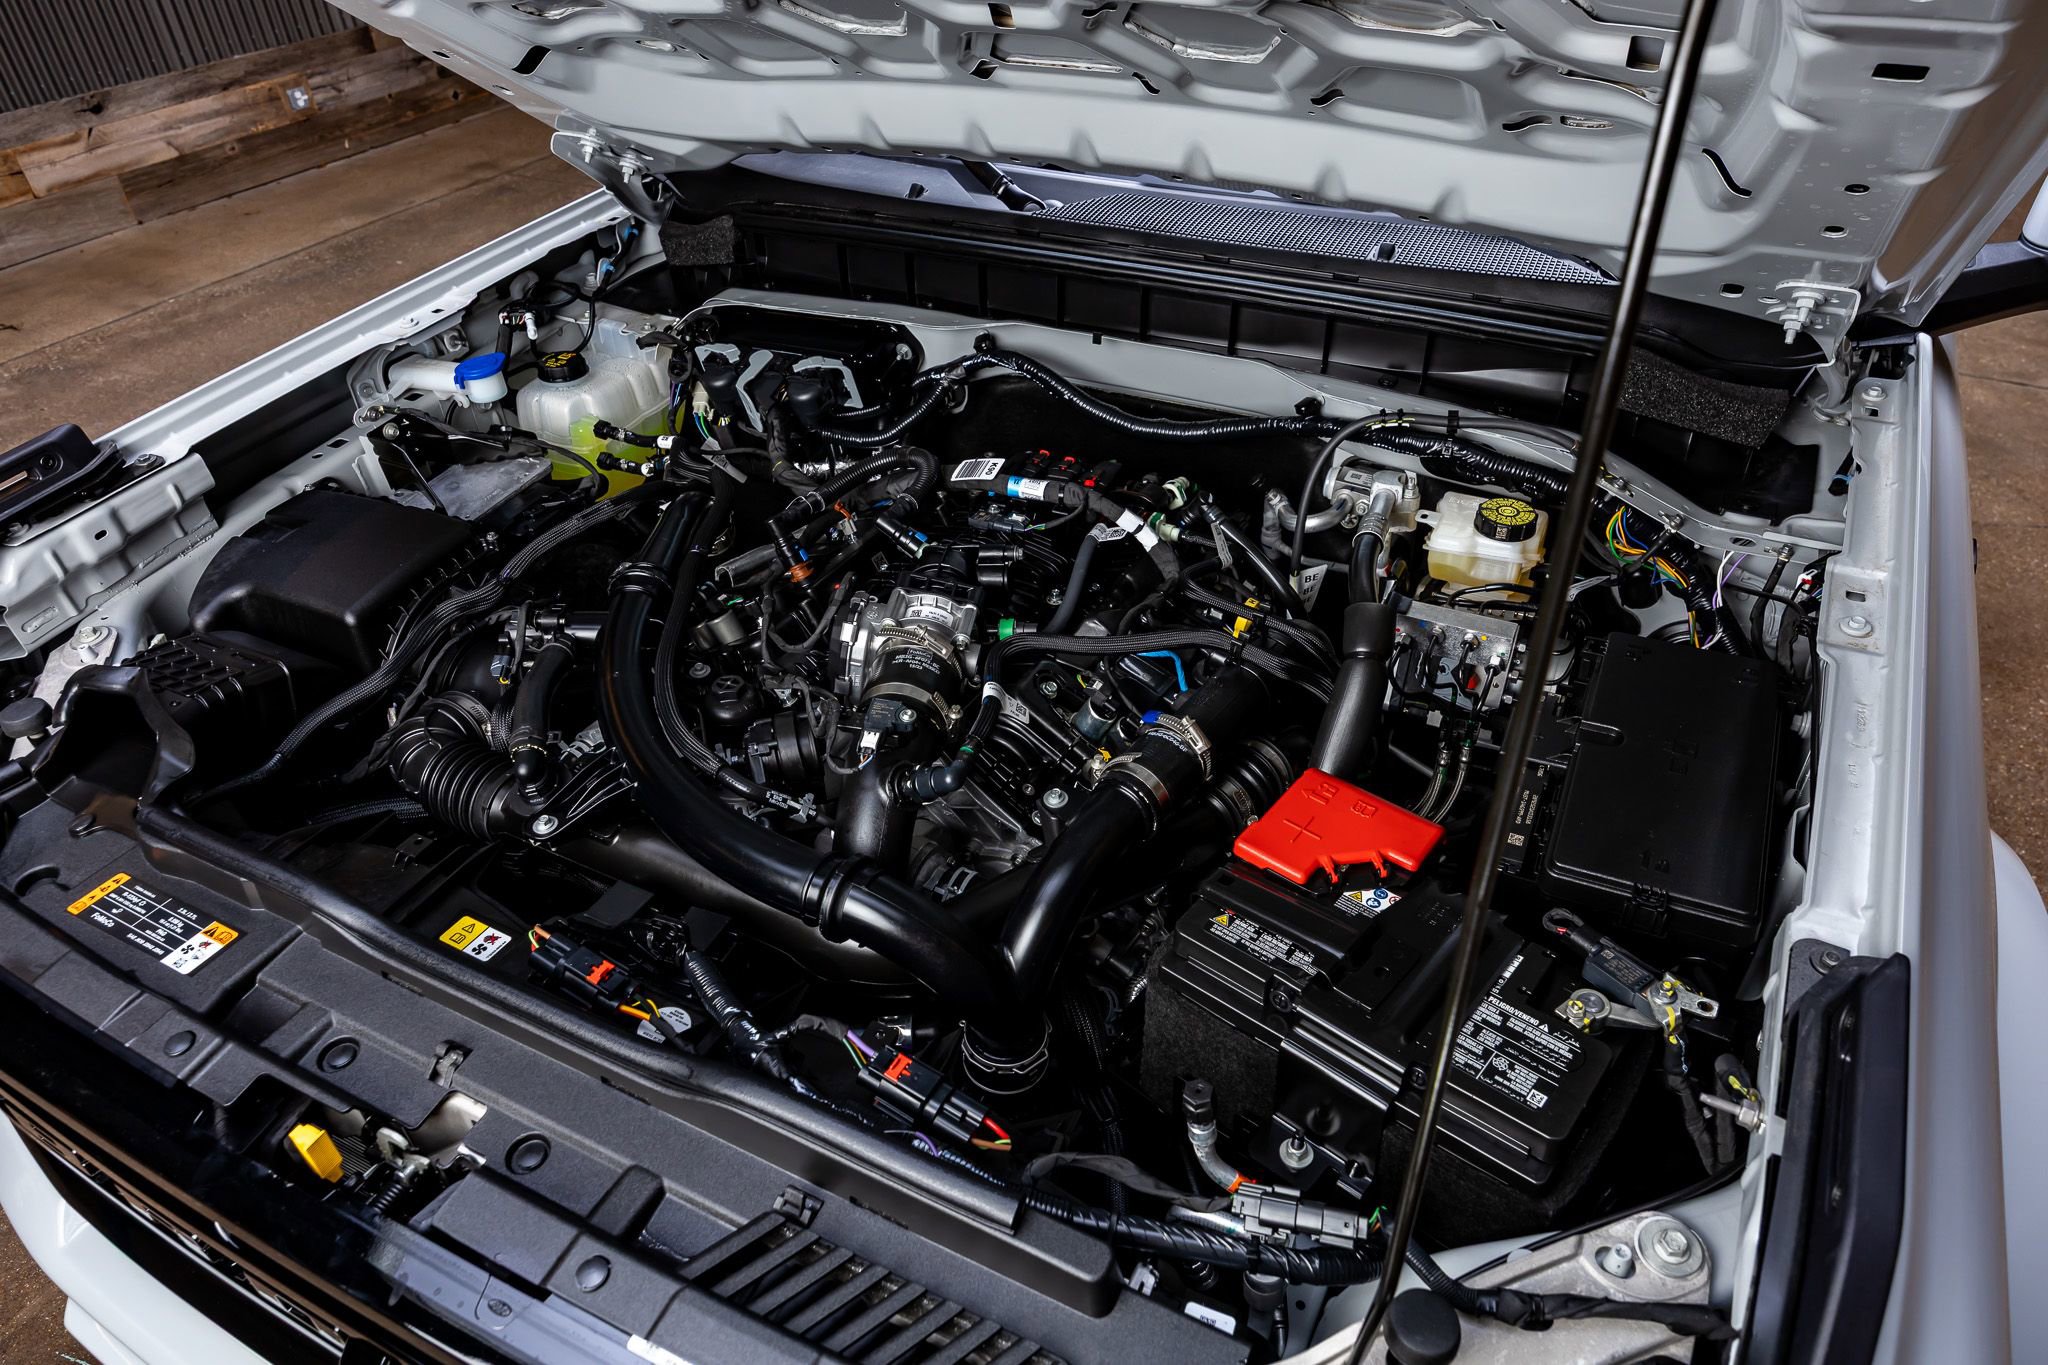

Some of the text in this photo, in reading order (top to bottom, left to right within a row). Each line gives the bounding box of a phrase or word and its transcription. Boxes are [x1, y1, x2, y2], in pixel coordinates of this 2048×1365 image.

[1304, 572, 1320, 584] BE
[91, 912, 116, 928] FoMoCo
[1488, 996, 1539, 1026] PELIGRO/VENENO
